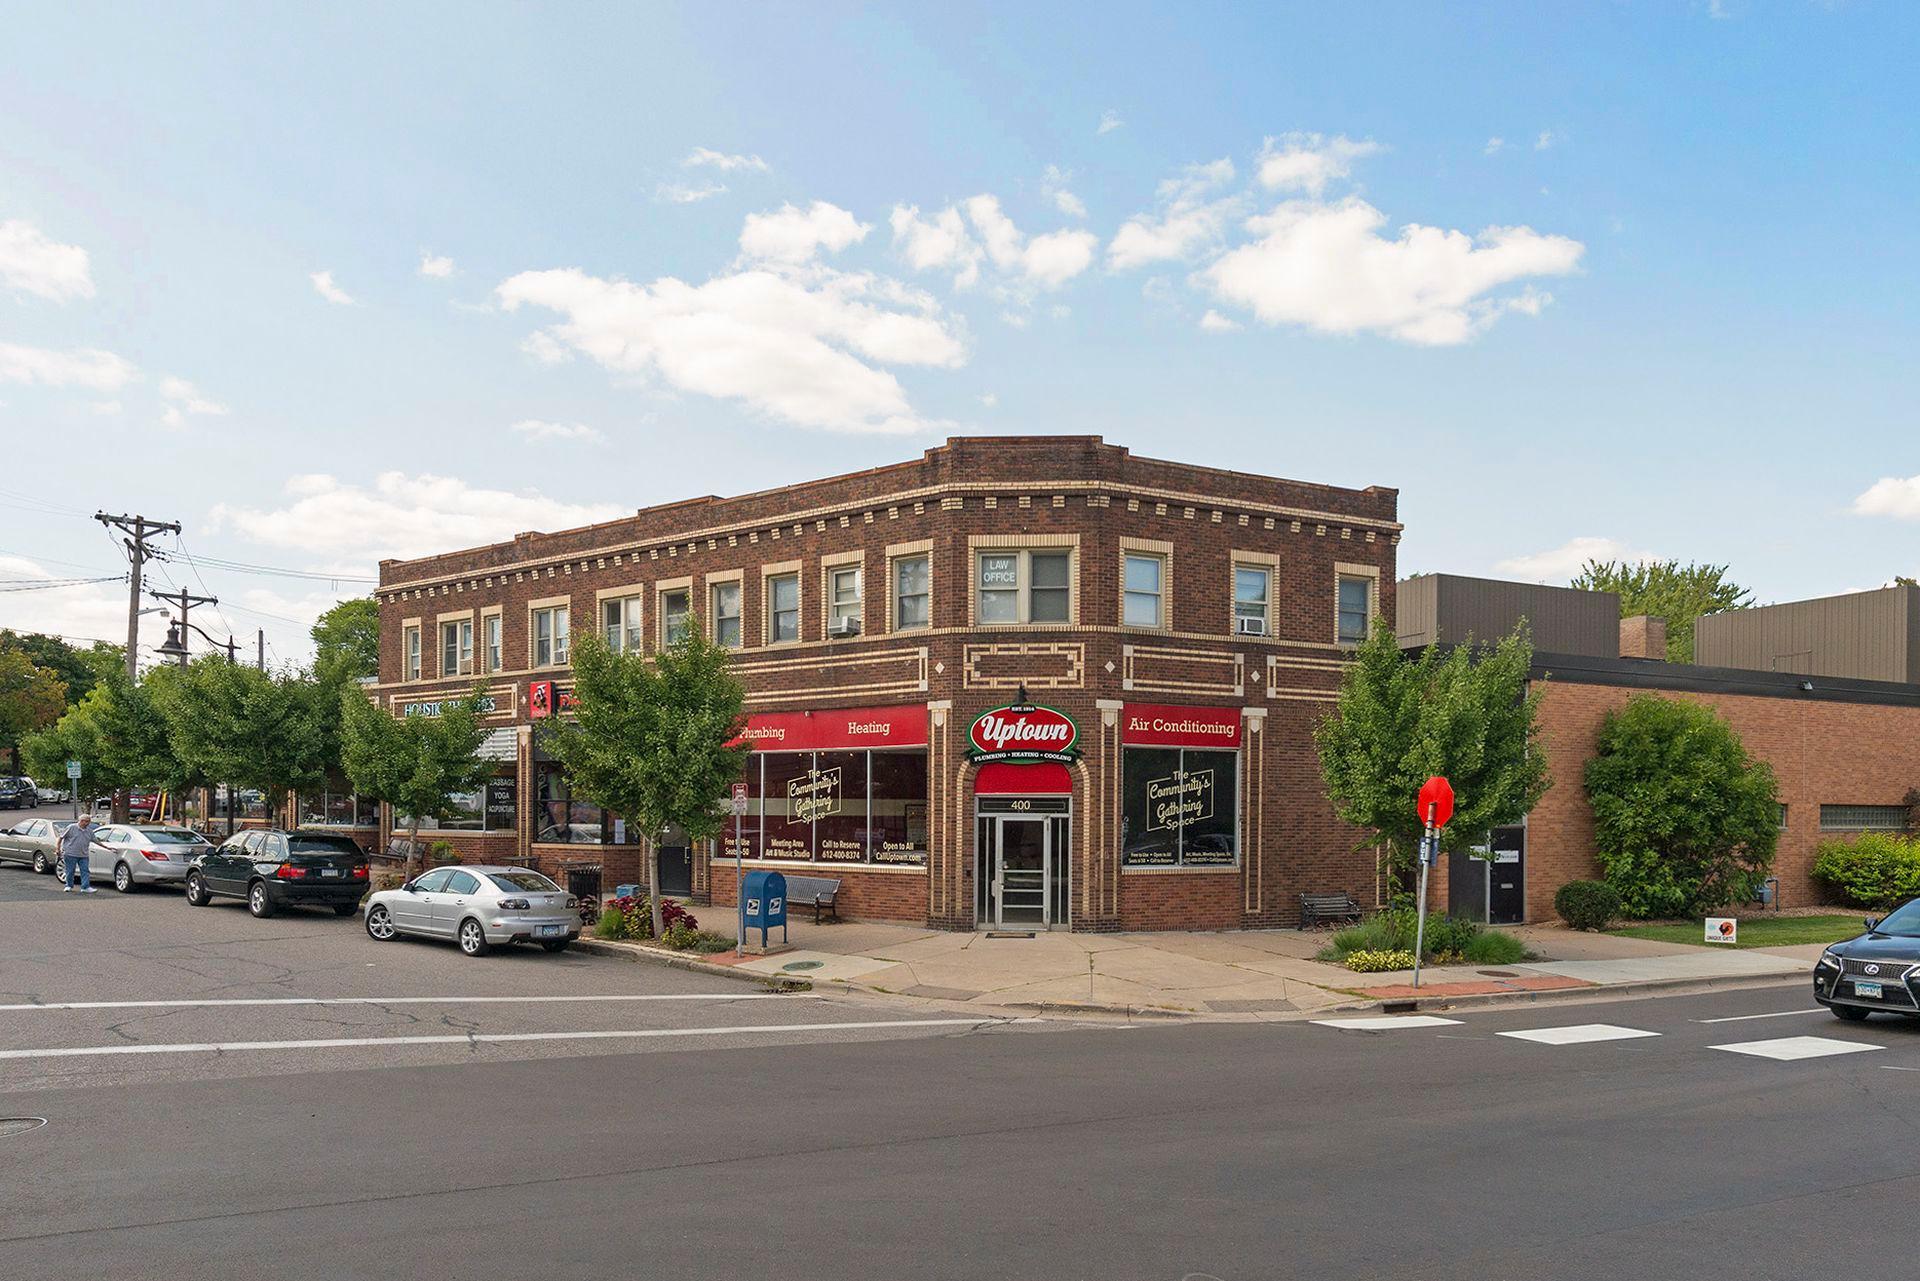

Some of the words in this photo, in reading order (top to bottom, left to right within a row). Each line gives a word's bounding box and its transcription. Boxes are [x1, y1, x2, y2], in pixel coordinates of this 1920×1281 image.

[990, 560, 1009, 570] LAW
[983, 572, 1015, 582] OFFICE
[848, 721, 890, 736] Heating
[981, 715, 1068, 749] Uptown
[1129, 718, 1150, 731] Air
[1153, 718, 1235, 738] Conditioning
[974, 753, 1007, 762] PLUMBING
[1044, 753, 1072, 761] COOLING
[807, 770, 821, 779] The
[1173, 771, 1189, 780] The
[790, 772, 839, 797] Community's
[1149, 775, 1211, 799] Community's
[494, 791, 510, 800] YOGA
[795, 794, 833, 818] Gathering
[1011, 800, 1031, 810] 400
[1156, 800, 1204, 823] Gathering
[802, 811, 826, 824] Space
[1166, 817, 1195, 831] Space
[771, 839, 792, 848] Meeting
[793, 840, 804, 848] Area
[822, 840, 833, 848] Call
[833, 841, 839, 849] to
[840, 840, 860, 849] Reserve
[883, 841, 898, 851] Open
[899, 842, 905, 850] to
[906, 842, 914, 850] All
[765, 849, 773, 857] Art
[778, 849, 793, 857] Music
[794, 850, 810, 858] Studio
[822, 850, 860, 859] 612-400-8374
[876, 852, 922, 862] CallUptown.com
